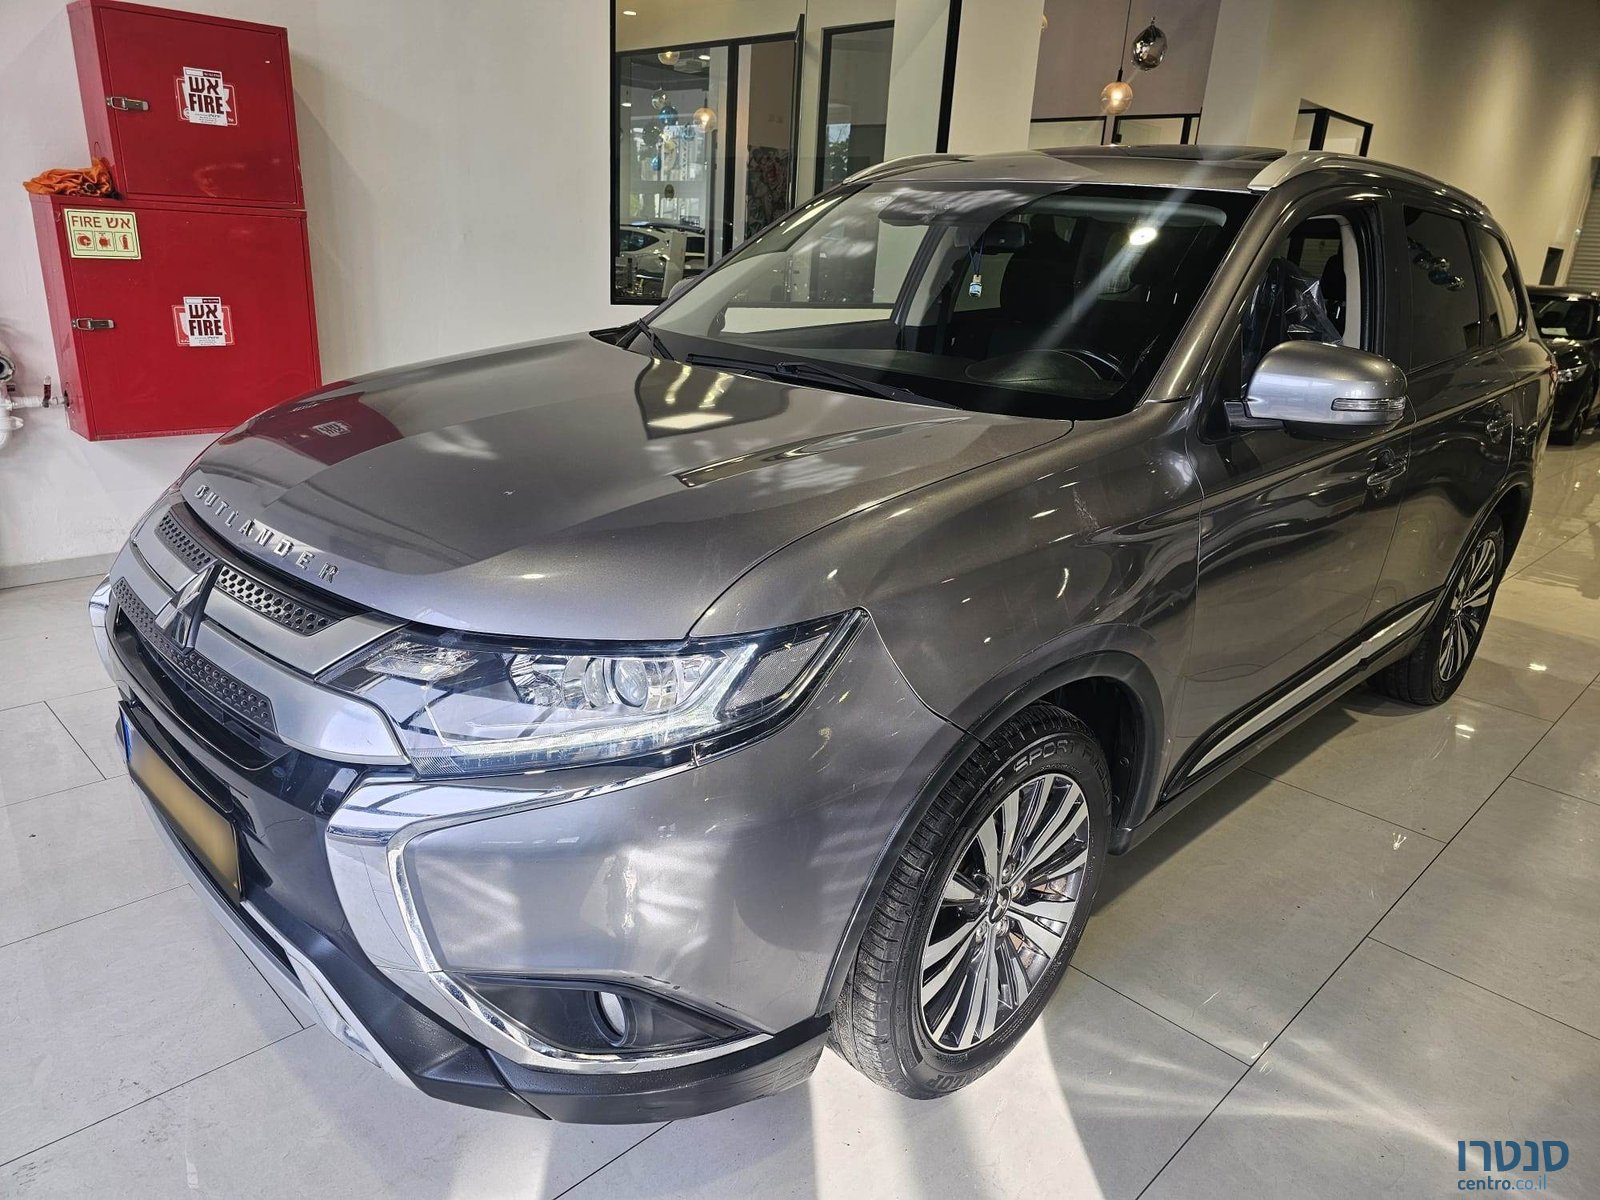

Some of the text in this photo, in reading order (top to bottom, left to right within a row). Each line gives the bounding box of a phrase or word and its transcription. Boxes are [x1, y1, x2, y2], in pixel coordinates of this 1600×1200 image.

[189, 77, 219, 96] אש
[189, 93, 224, 115] FIRE
[71, 215, 131, 229] FIRE אש
[189, 304, 218, 319] אש
[189, 319, 223, 336] FIRE
[194, 484, 340, 584] OUTLANDER
[1013, 739, 1075, 772] SPORT
